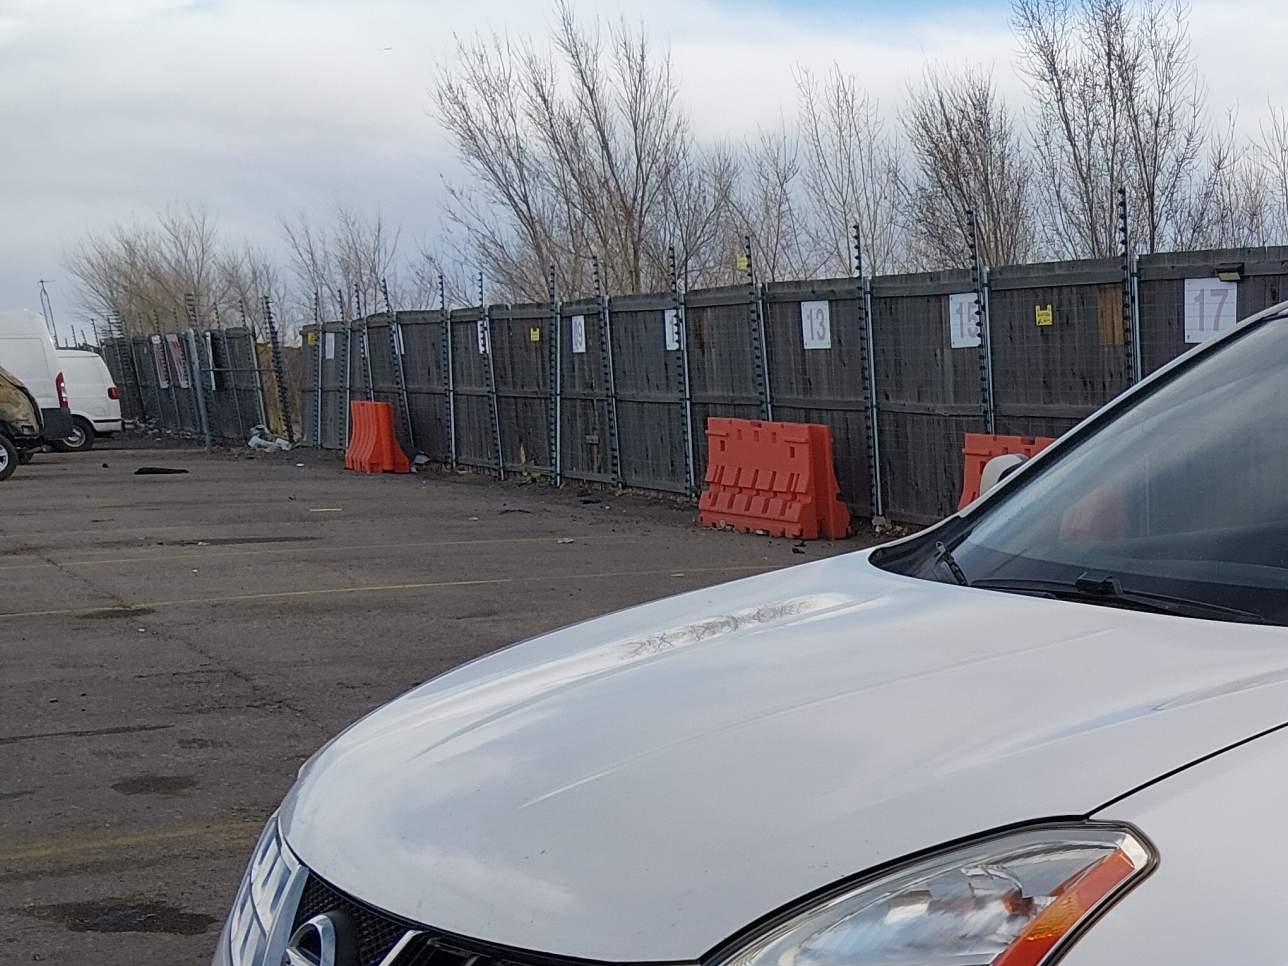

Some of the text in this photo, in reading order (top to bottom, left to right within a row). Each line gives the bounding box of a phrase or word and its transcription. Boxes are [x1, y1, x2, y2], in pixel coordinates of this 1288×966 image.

[806, 307, 826, 341] 13
[956, 301, 979, 338] 15
[1193, 287, 1229, 331] 17
